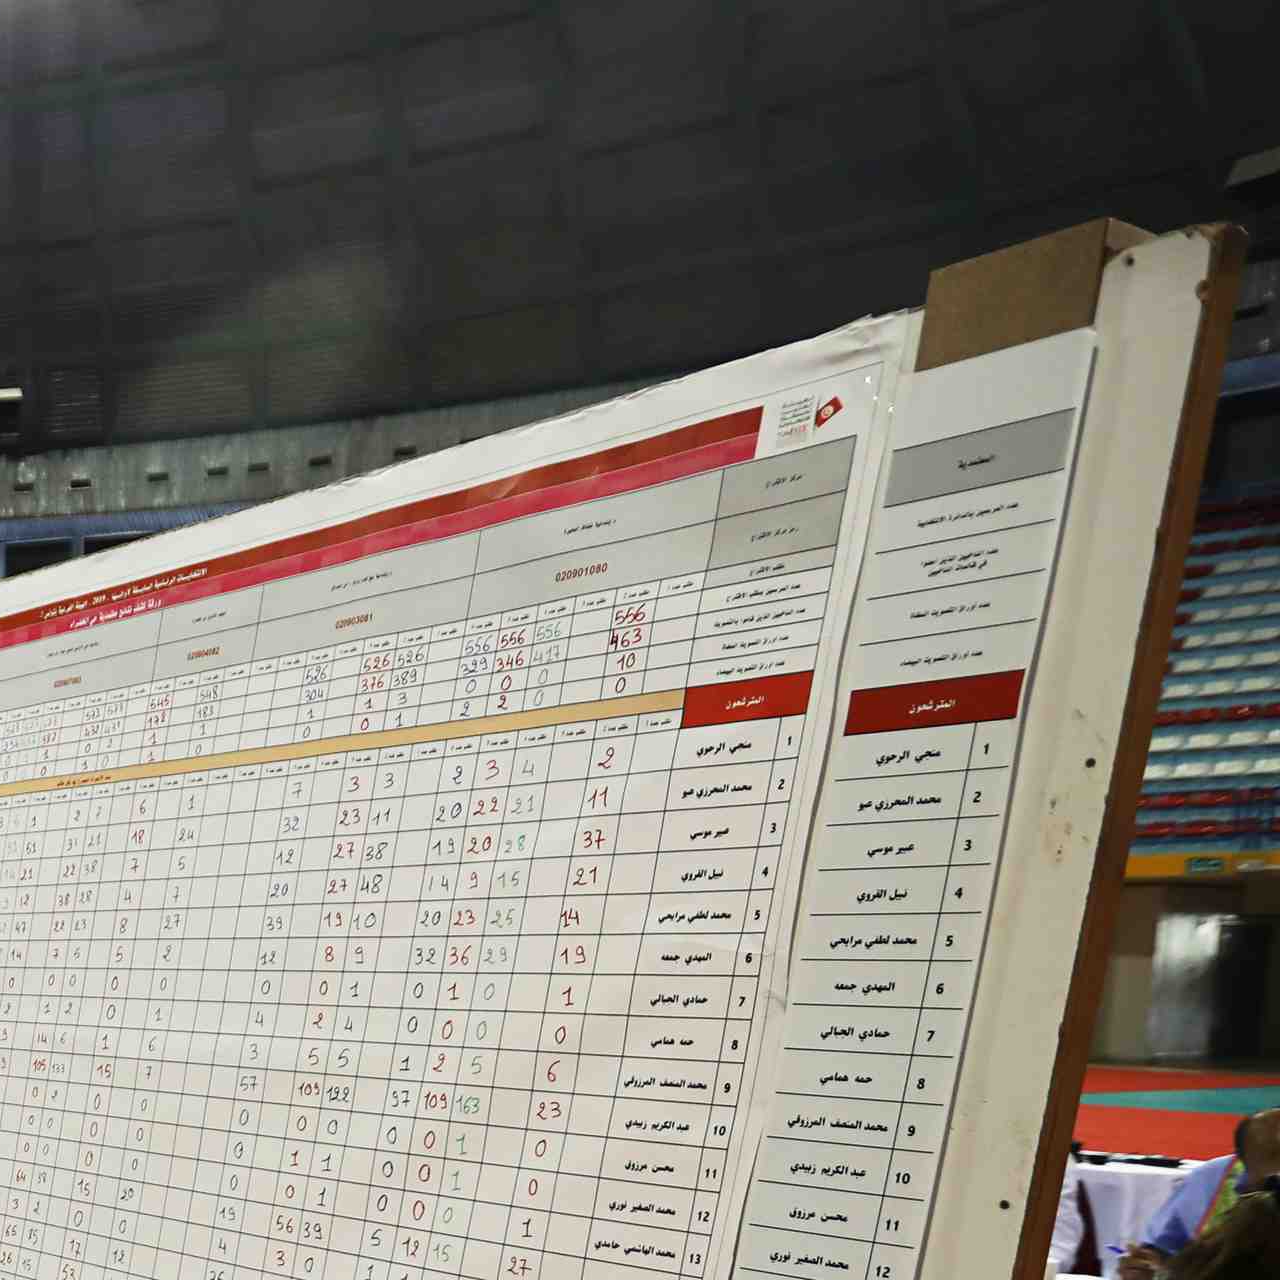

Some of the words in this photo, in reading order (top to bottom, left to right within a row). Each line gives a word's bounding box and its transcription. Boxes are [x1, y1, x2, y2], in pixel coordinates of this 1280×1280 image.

[614, 603, 646, 624] 556
[500, 628, 525, 648] 556
[496, 650, 524, 672] 346
[616, 652, 636, 670] 10
[500, 674, 512, 691] 0
[614, 676, 626, 693] 0
[497, 694, 508, 710] 2
[908, 700, 956, 715] المترشحون
[984, 744, 990, 756] 1
[876, 750, 910, 767] الرحوي
[485, 759, 500, 780] 3
[588, 786, 608, 808] 11
[874, 796, 914, 812] المحرزي
[916, 796, 942, 804] محمد
[972, 791, 982, 803] 2
[472, 796, 499, 816] 22
[467, 835, 492, 854] 20
[583, 829, 606, 849] 37
[963, 839, 972, 851] 3
[896, 843, 914, 855] عبير
[470, 872, 479, 889] 9
[572, 866, 598, 886] 21
[856, 889, 887, 905] القروي
[888, 888, 908, 901] نبيل
[954, 887, 963, 899] 4
[453, 909, 476, 926] 23
[830, 936, 862, 949] مرايحي
[864, 935, 890, 948] لطفي
[892, 936, 917, 945] محمد
[945, 935, 954, 947] 5
[448, 944, 472, 966] 36
[560, 945, 586, 965] 19
[862, 982, 896, 996] المهدي
[936, 983, 944, 994] 6
[561, 986, 574, 1006] 1
[554, 1025, 567, 1044] 0
[820, 1026, 854, 1040] الجبالي
[858, 1028, 890, 1042] حمادي
[927, 1030, 936, 1042] 7
[546, 1060, 561, 1082] 6
[916, 1078, 925, 1090] 8
[536, 1100, 562, 1120] 23
[787, 1114, 826, 1128] المرزوقي
[830, 1118, 862, 1129] المنصف
[864, 1122, 888, 1132] محمد
[907, 1125, 916, 1136] 9
[534, 1139, 547, 1158] 0
[821, 1166, 848, 1176] الكريم
[850, 1169, 866, 1180] عبد
[895, 1172, 910, 1184] 10
[528, 1178, 538, 1196] 0
[788, 1208, 816, 1220] مرزوق
[820, 1212, 848, 1222] محسن
[522, 1218, 533, 1238] 1
[886, 1219, 900, 1231] 11
[769, 1251, 791, 1263] نوري
[794, 1254, 823, 1265] الصغير
[507, 1256, 533, 1276] 27
[825, 1260, 848, 1270] محمد
[876, 1266, 891, 1278] 12
